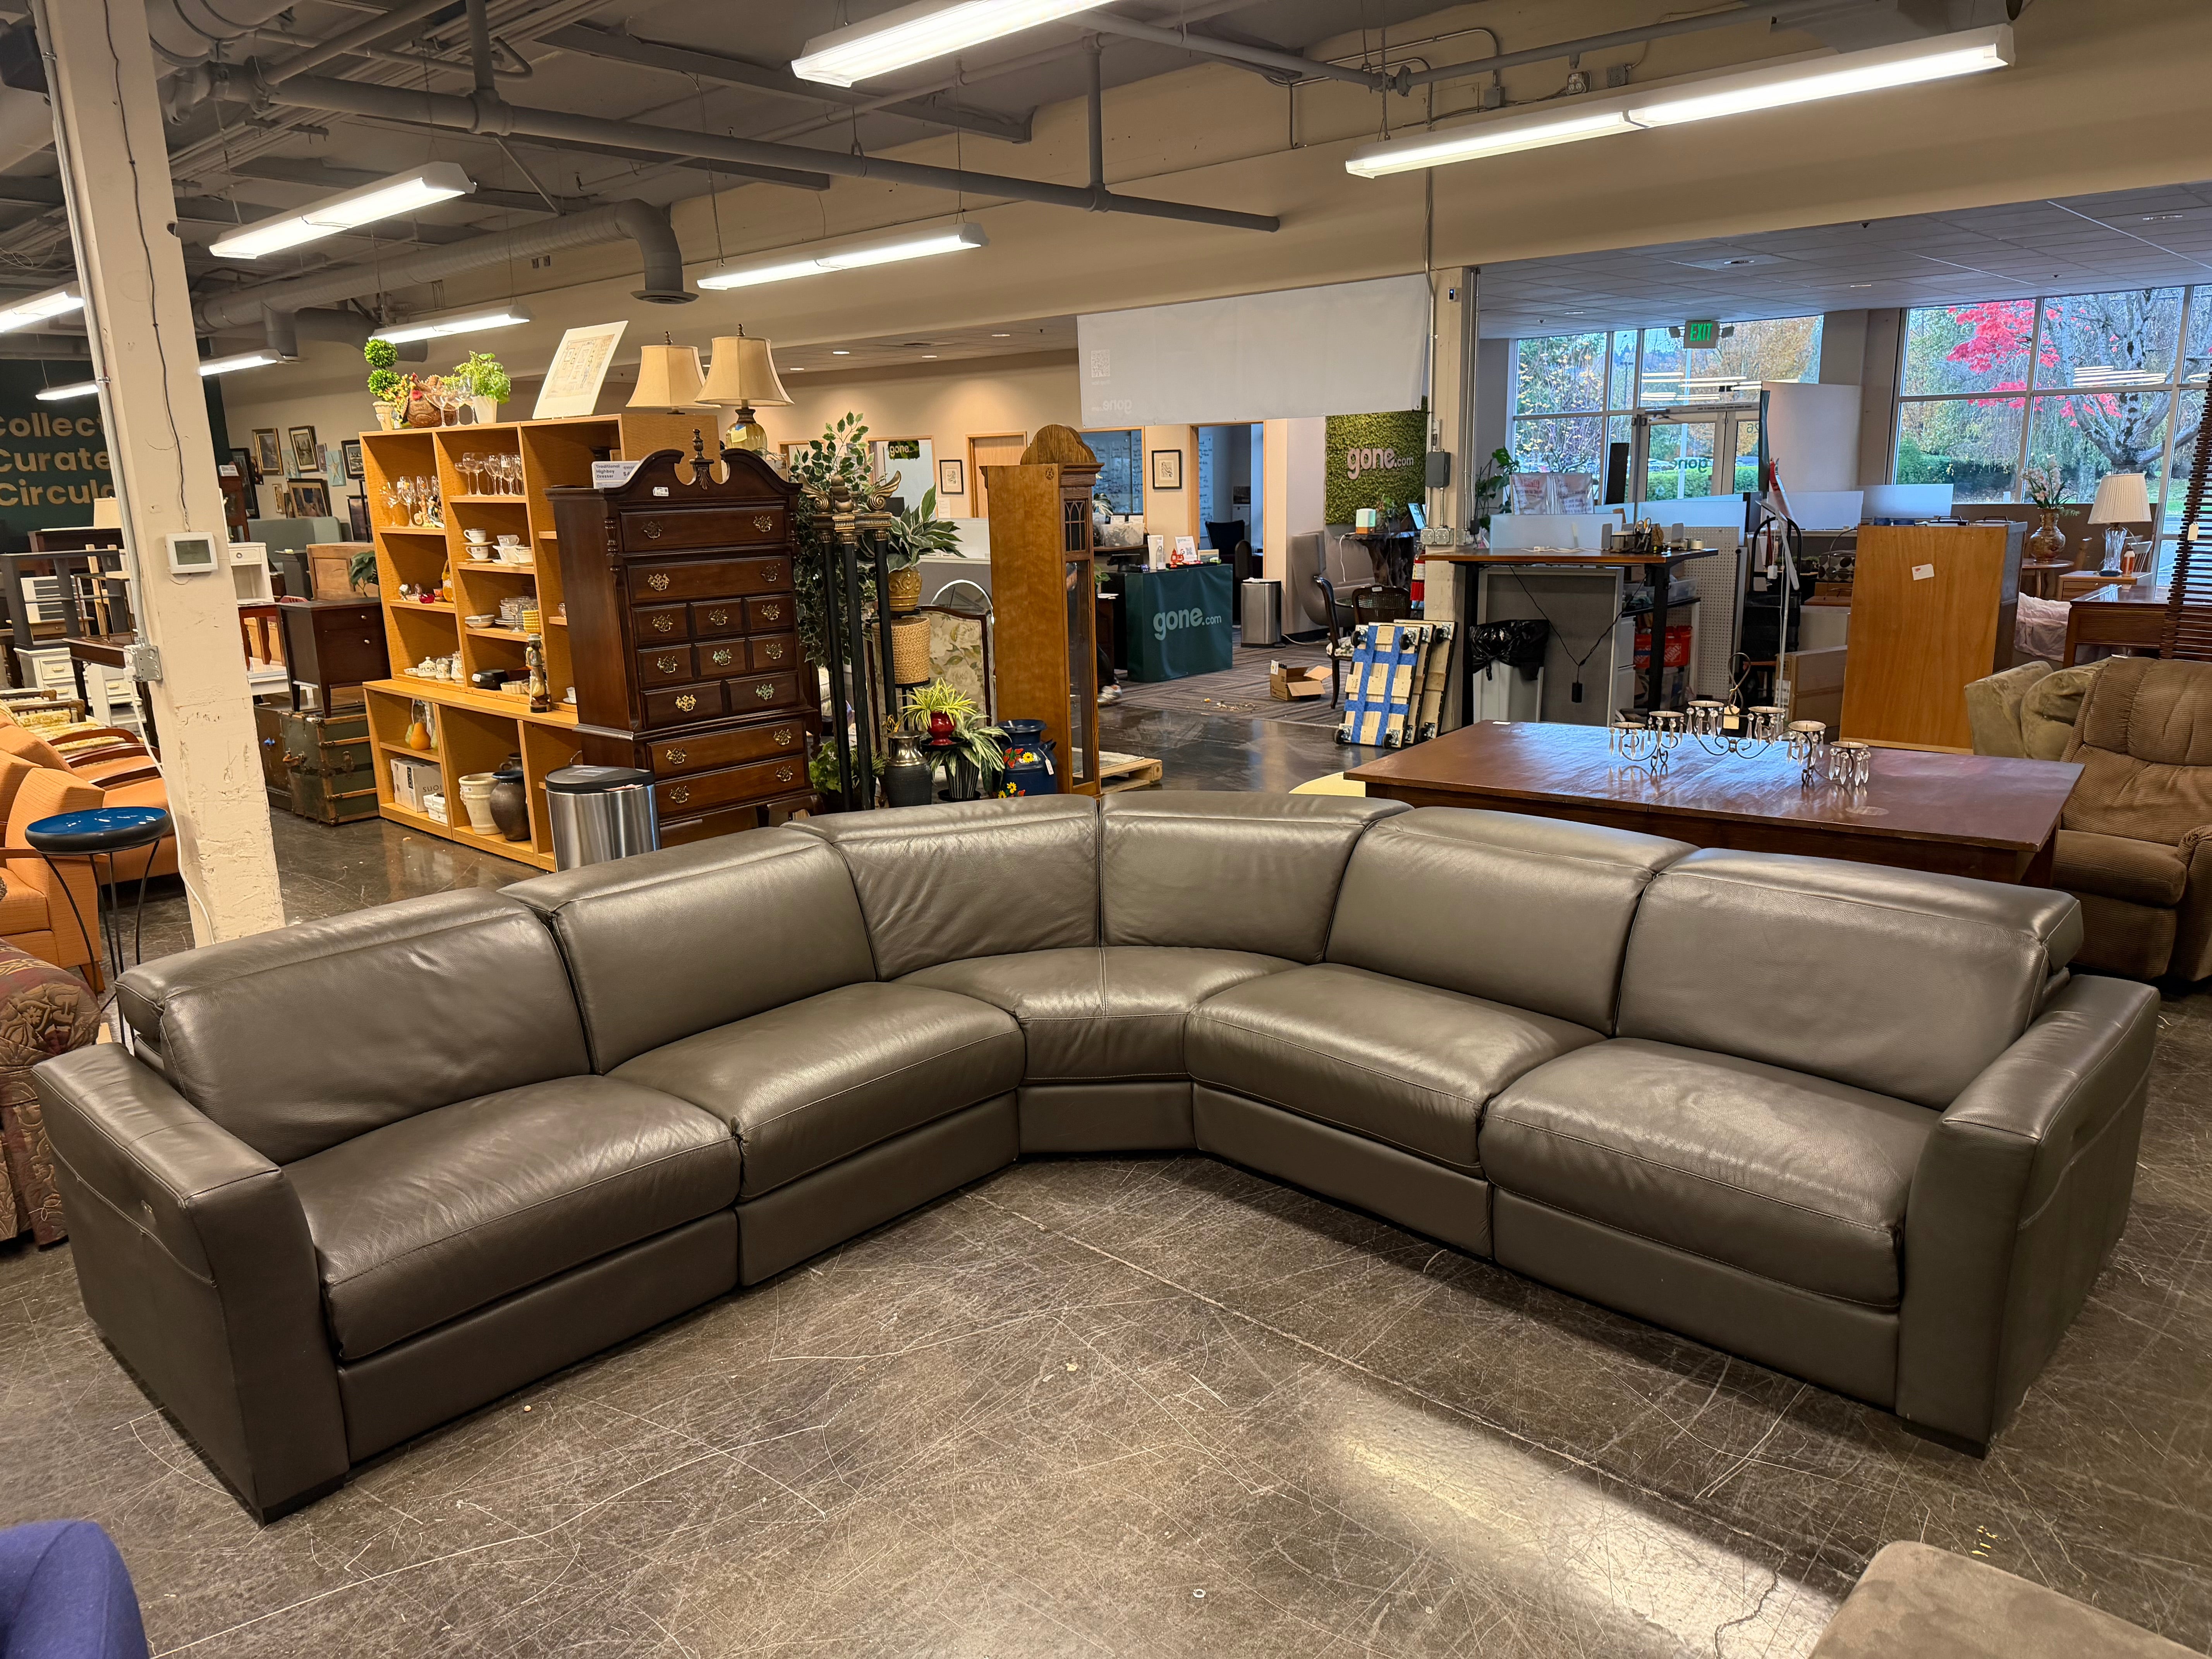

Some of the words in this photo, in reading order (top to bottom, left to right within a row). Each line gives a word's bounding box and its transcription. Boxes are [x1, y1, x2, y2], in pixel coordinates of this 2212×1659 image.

[1690, 323, 1713, 341] EXIT
[1347, 448, 1413, 480] gone.com
[1153, 608, 1221, 641] gone.com
